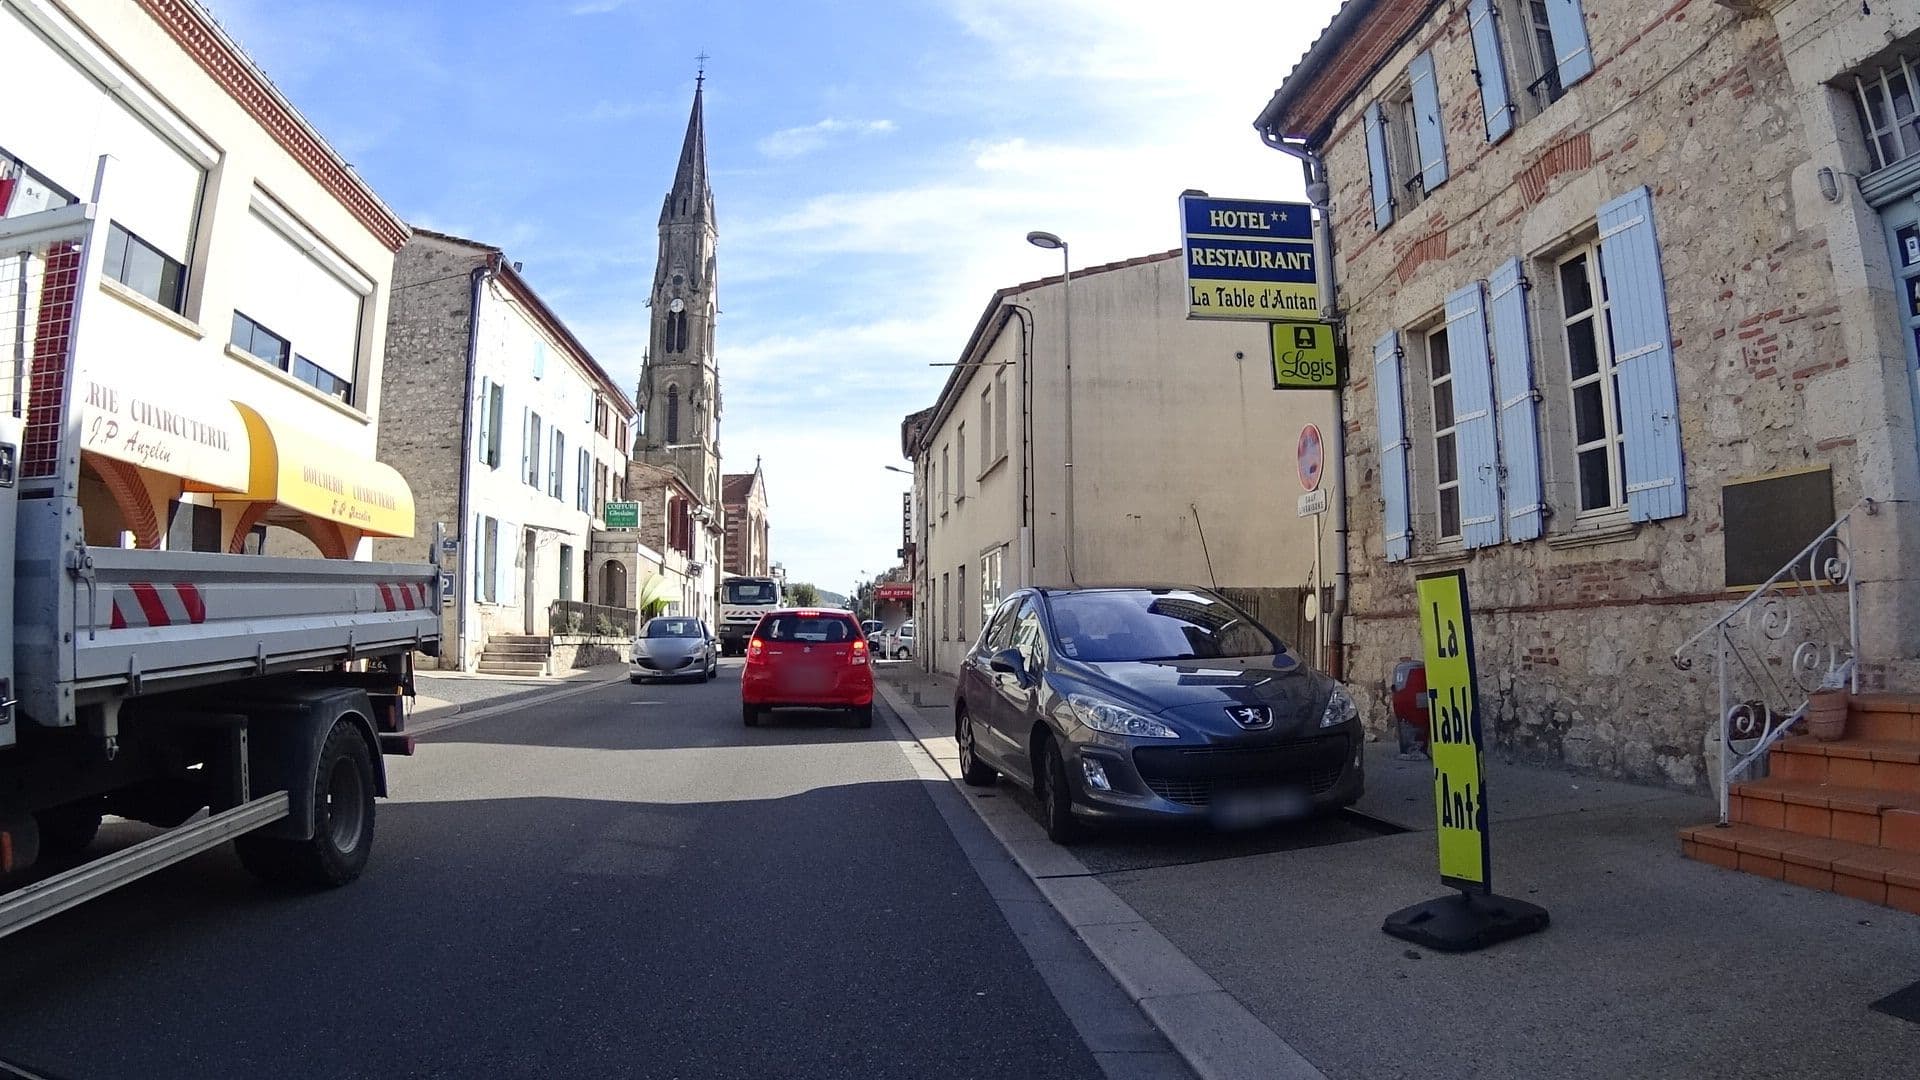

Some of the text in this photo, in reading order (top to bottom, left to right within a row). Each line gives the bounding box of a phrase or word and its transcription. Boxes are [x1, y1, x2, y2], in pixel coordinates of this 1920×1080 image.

[1210, 210, 1271, 230] HOTEL
[1191, 248, 1312, 270] RESTAURANT
[1191, 285, 1317, 310] La Table d'Antan
[1281, 350, 1334, 382] Logis
[86, 381, 230, 452] RIE CHARCUTERIE
[303, 464, 344, 496] BOUCHERIE
[1433, 601, 1459, 658] La
[1428, 686, 1475, 746] Tabl
